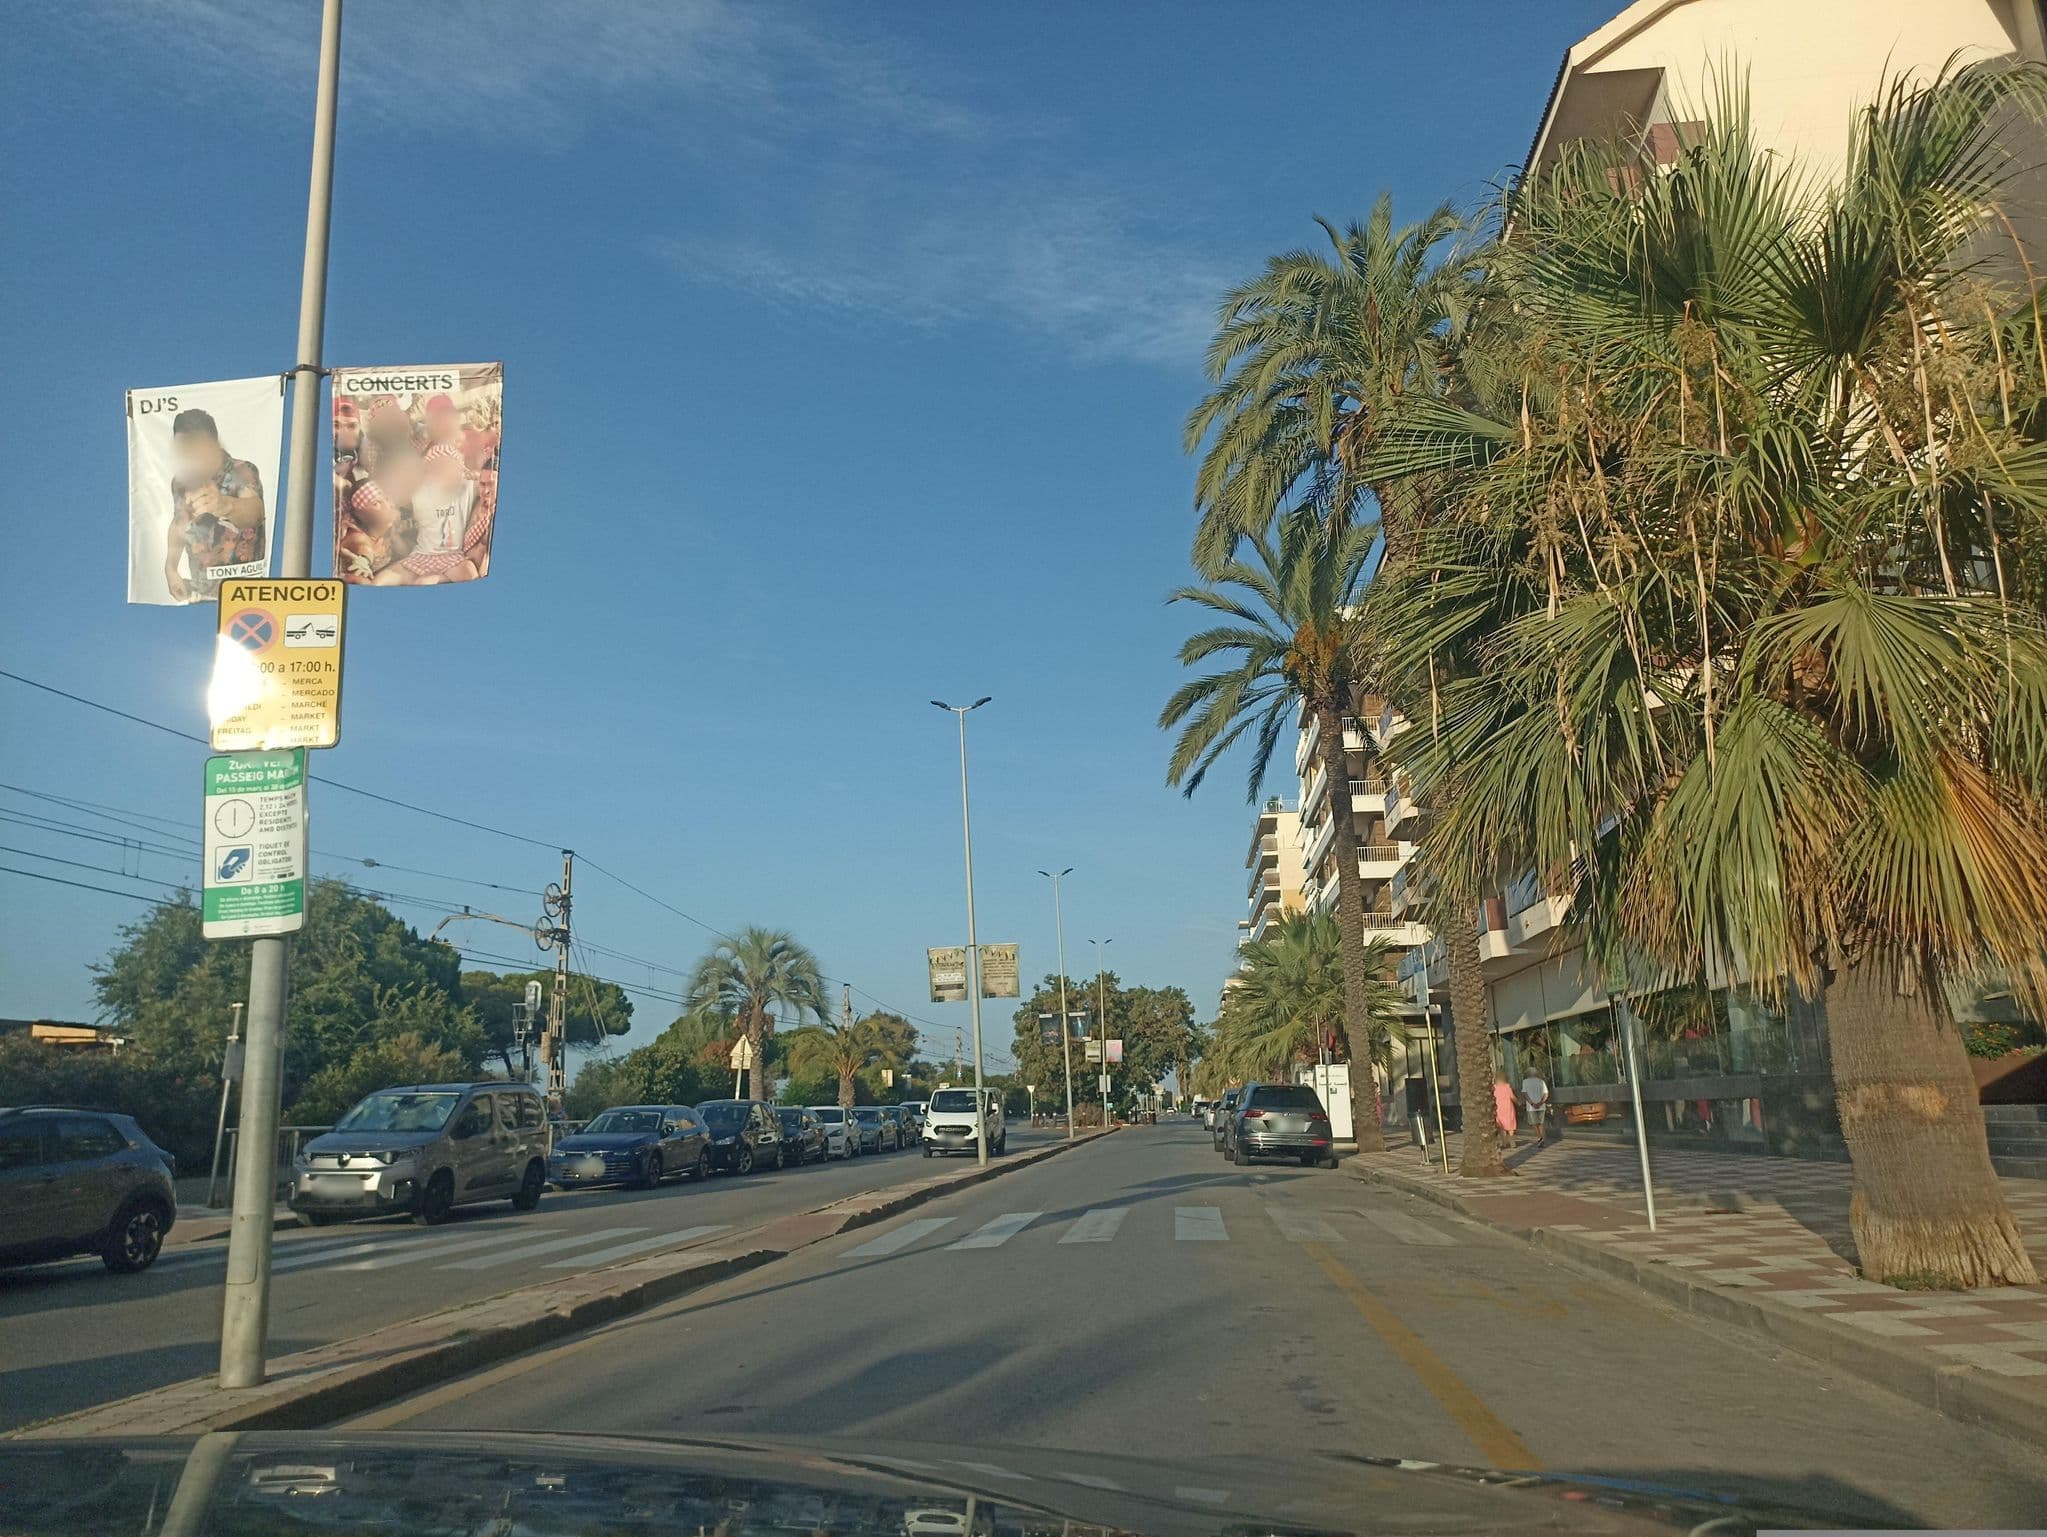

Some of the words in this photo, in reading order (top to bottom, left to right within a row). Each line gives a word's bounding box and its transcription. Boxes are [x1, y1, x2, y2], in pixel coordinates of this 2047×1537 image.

[346, 373, 453, 392] CONCERTS
[140, 396, 179, 415] DJ'S
[209, 567, 239, 578] TONY
[231, 584, 336, 602] ATENCIÓ!
[278, 664, 286, 673] a
[290, 661, 321, 673] 17:00
[324, 661, 336, 673] h.
[291, 689, 336, 697] MERCADO
[290, 712, 325, 720] MARKET
[217, 727, 252, 735] FREITAG
[290, 724, 320, 732] MARKT
[216, 771, 264, 784] PASSEIG
[240, 886, 252, 895] De
[261, 886, 267, 894] a
[268, 884, 279, 893] 20
